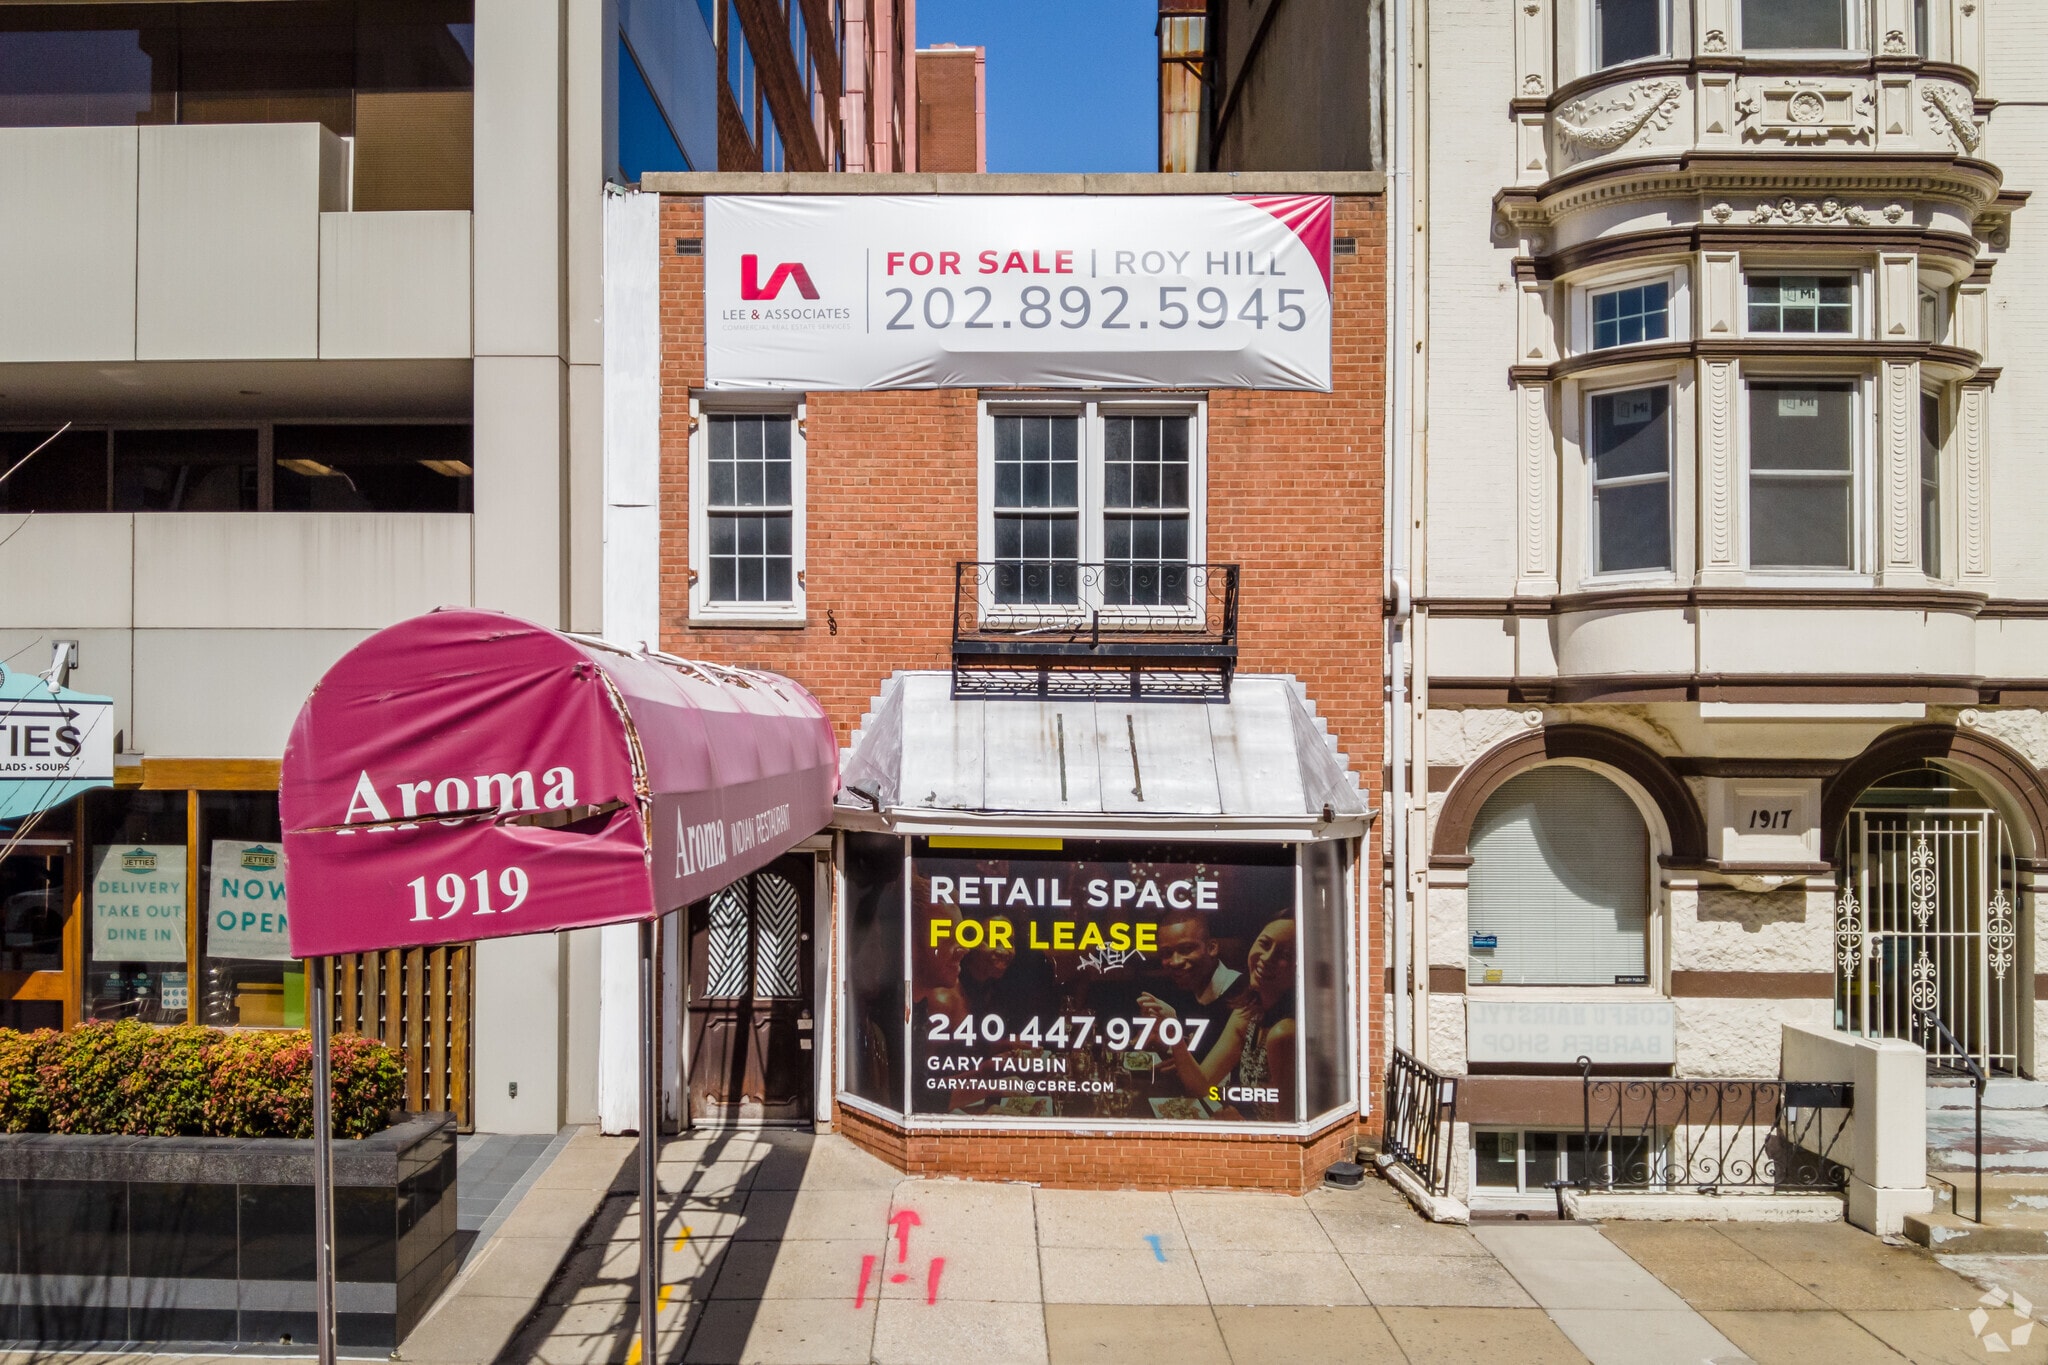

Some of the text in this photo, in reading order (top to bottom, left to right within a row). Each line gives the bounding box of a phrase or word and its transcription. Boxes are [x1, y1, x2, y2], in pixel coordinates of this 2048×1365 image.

[887, 249, 1286, 276] FOR SALE ROY HILL
[722, 308, 850, 320] LEE & ASSOCIATES
[885, 284, 1307, 332] 202.892.5945
[722, 322, 852, 332] COMMERCIAL REAL ESTATE SERVICES
[0, 725, 82, 757] IES
[36, 763, 70, 772] SOUPS
[336, 766, 579, 835] Aroma
[1749, 809, 1792, 829] 1917
[675, 803, 791, 879] Aroma INDIAN RESTAURANT
[244, 855, 275, 864] JETTIES
[99, 881, 180, 894] DELIVERY
[222, 878, 286, 900] NOW
[407, 866, 529, 922] 1919
[930, 876, 1219, 910] RETAIL SPACE
[97, 905, 181, 918] TAKE OUT
[108, 928, 171, 941] DINE IN
[930, 919, 1158, 952] FOR LEASE
[927, 1013, 1210, 1051] 240.447.9707
[927, 1056, 1066, 1073] GARY TAUBIN
[926, 1078, 1114, 1093] GARY.TAUBIN@CBRE.COM
[1228, 1087, 1279, 1103] CBRE
